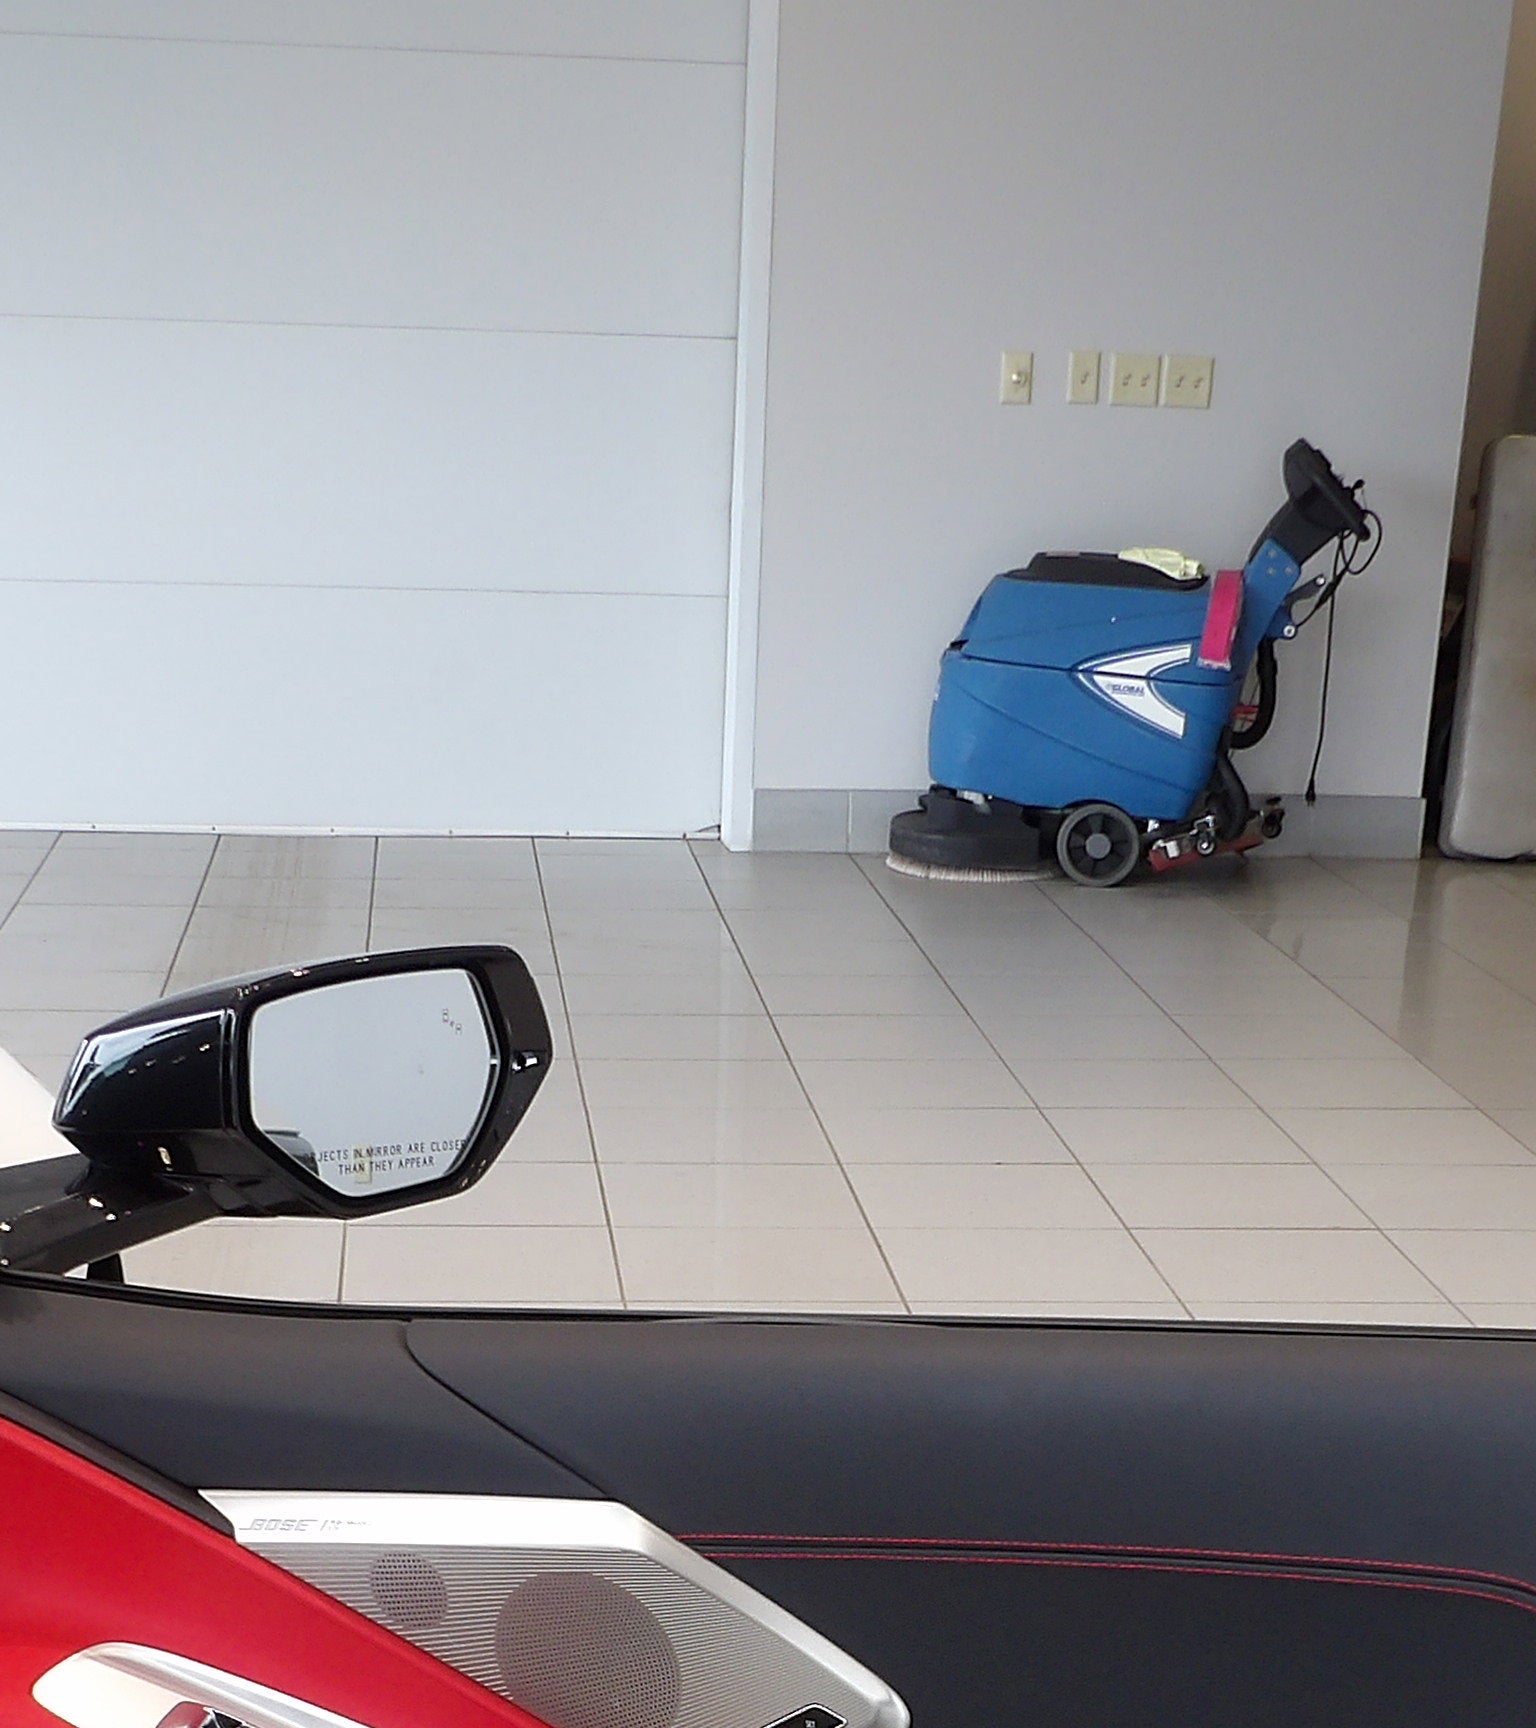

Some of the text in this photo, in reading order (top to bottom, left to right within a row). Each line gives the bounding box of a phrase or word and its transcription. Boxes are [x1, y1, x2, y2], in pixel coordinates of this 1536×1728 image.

[366, 1144, 402, 1158] MIRROR
[408, 1143, 425, 1154] ARE
[338, 1156, 435, 1175] THAN THEY APPEAR
[239, 1518, 318, 1531] BOSE
